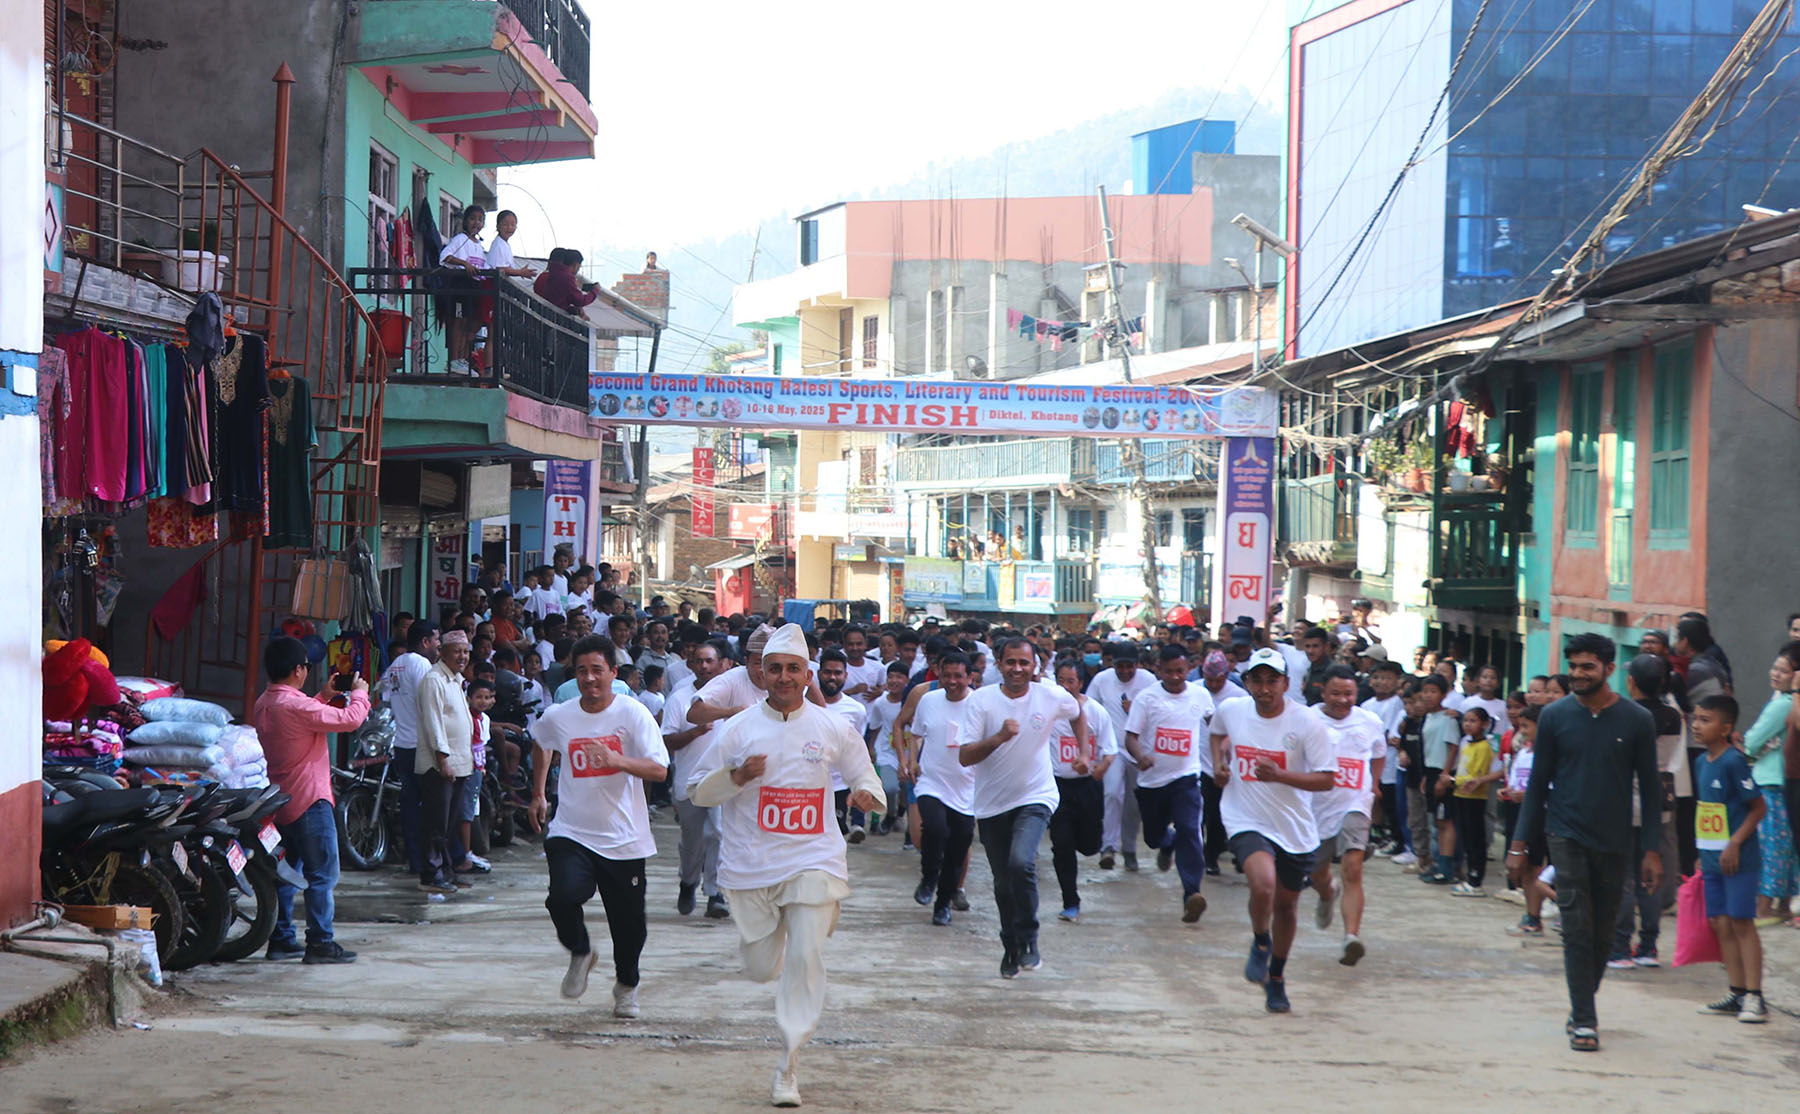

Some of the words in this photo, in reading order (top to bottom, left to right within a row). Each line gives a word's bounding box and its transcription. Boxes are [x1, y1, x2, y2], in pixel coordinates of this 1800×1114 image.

[588, 373, 644, 391] Second
[650, 374, 698, 392] Grand
[704, 377, 773, 399] Khotang
[780, 379, 832, 397] Halesi
[839, 380, 898, 402] Sports,
[905, 381, 972, 404] Literary
[979, 384, 1009, 400] and
[1016, 385, 1085, 402] Tourism
[800, 405, 825, 415] 2025
[827, 403, 978, 426] FINISH
[989, 410, 1026, 421] Diktel,
[1031, 411, 1079, 424] Khotang
[762, 804, 818, 831] ०८०
